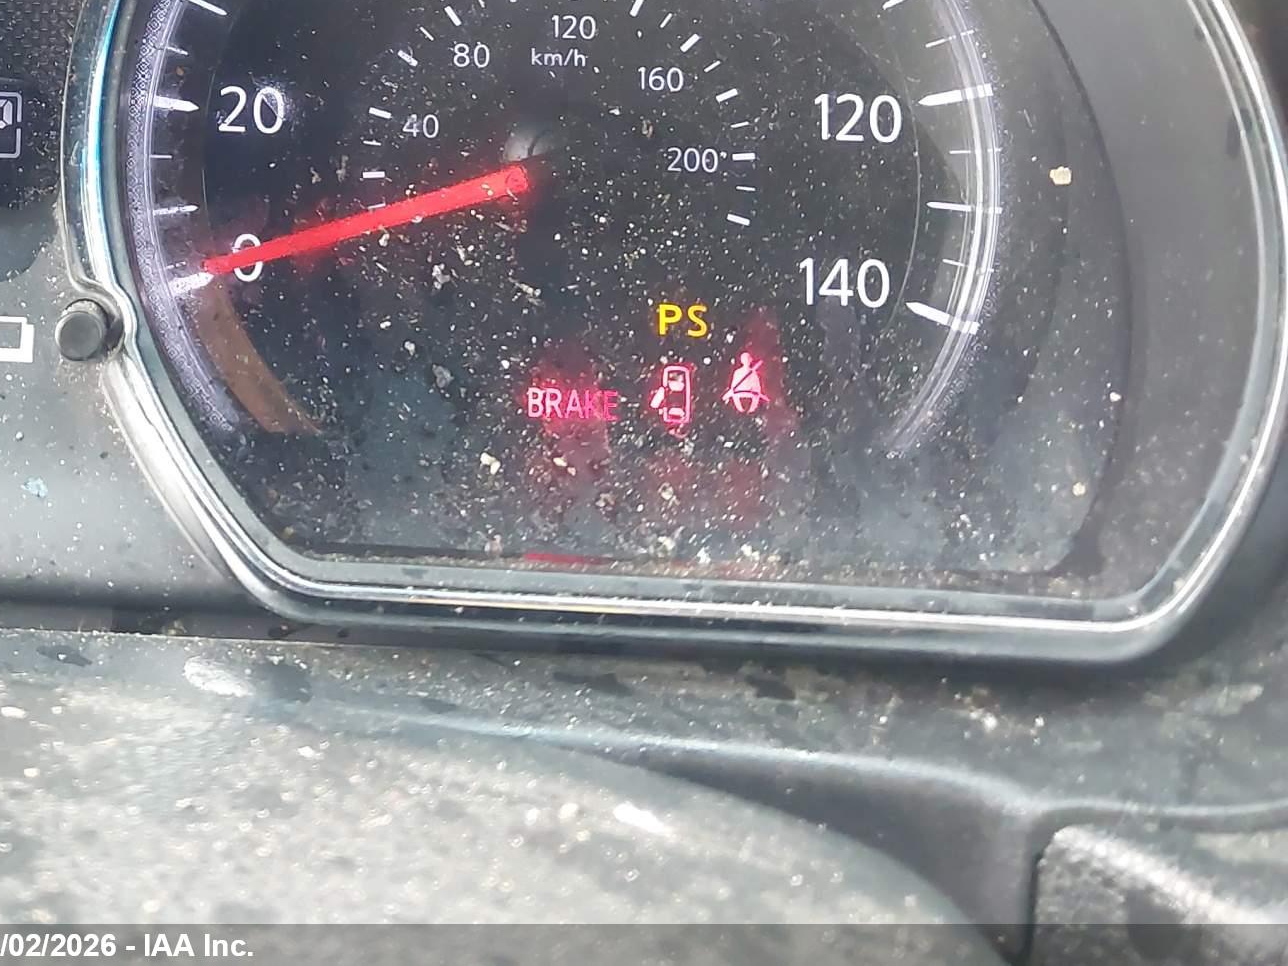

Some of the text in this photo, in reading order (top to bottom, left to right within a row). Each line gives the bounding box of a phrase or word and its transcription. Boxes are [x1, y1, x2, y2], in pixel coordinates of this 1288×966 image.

[551, 14, 596, 40] 120
[453, 41, 491, 68] 80
[530, 47, 587, 68] km/h
[638, 66, 685, 93] 160
[218, 87, 285, 136] 20
[816, 93, 902, 143] 120
[402, 114, 440, 140] 40
[667, 147, 719, 174] 200
[232, 234, 263, 282] 0
[799, 258, 891, 308] 140
[658, 304, 708, 338] PS
[526, 388, 618, 422] BRAKE
